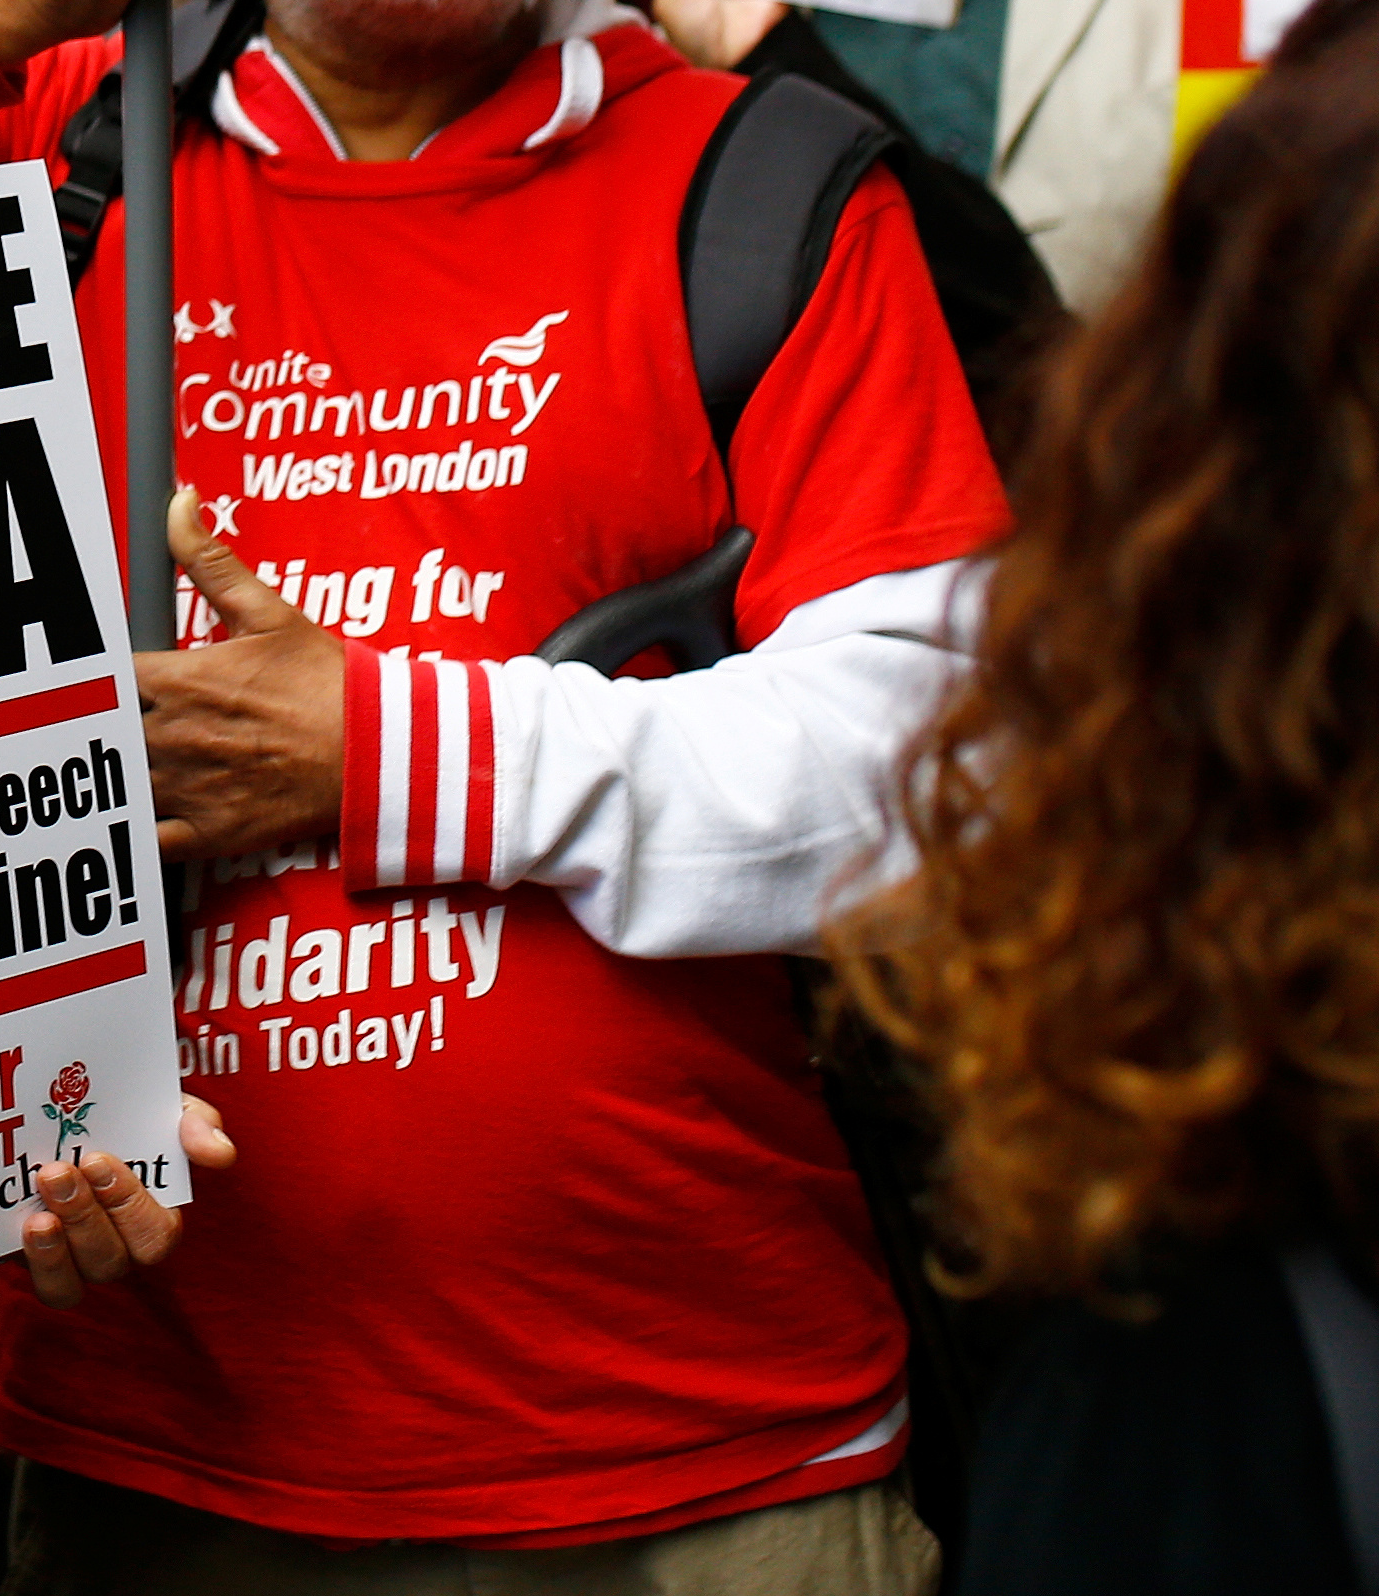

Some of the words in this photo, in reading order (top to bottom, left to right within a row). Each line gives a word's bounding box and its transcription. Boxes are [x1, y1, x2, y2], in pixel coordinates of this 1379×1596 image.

[179, 365, 562, 440] Community
[229, 349, 333, 392] unite
[242, 449, 355, 502] West
[359, 440, 529, 499] London
[410, 547, 505, 624] for
[173, 896, 507, 1015] lidarity
[179, 1023, 241, 1079] oin
[258, 994, 446, 1072] Today!
